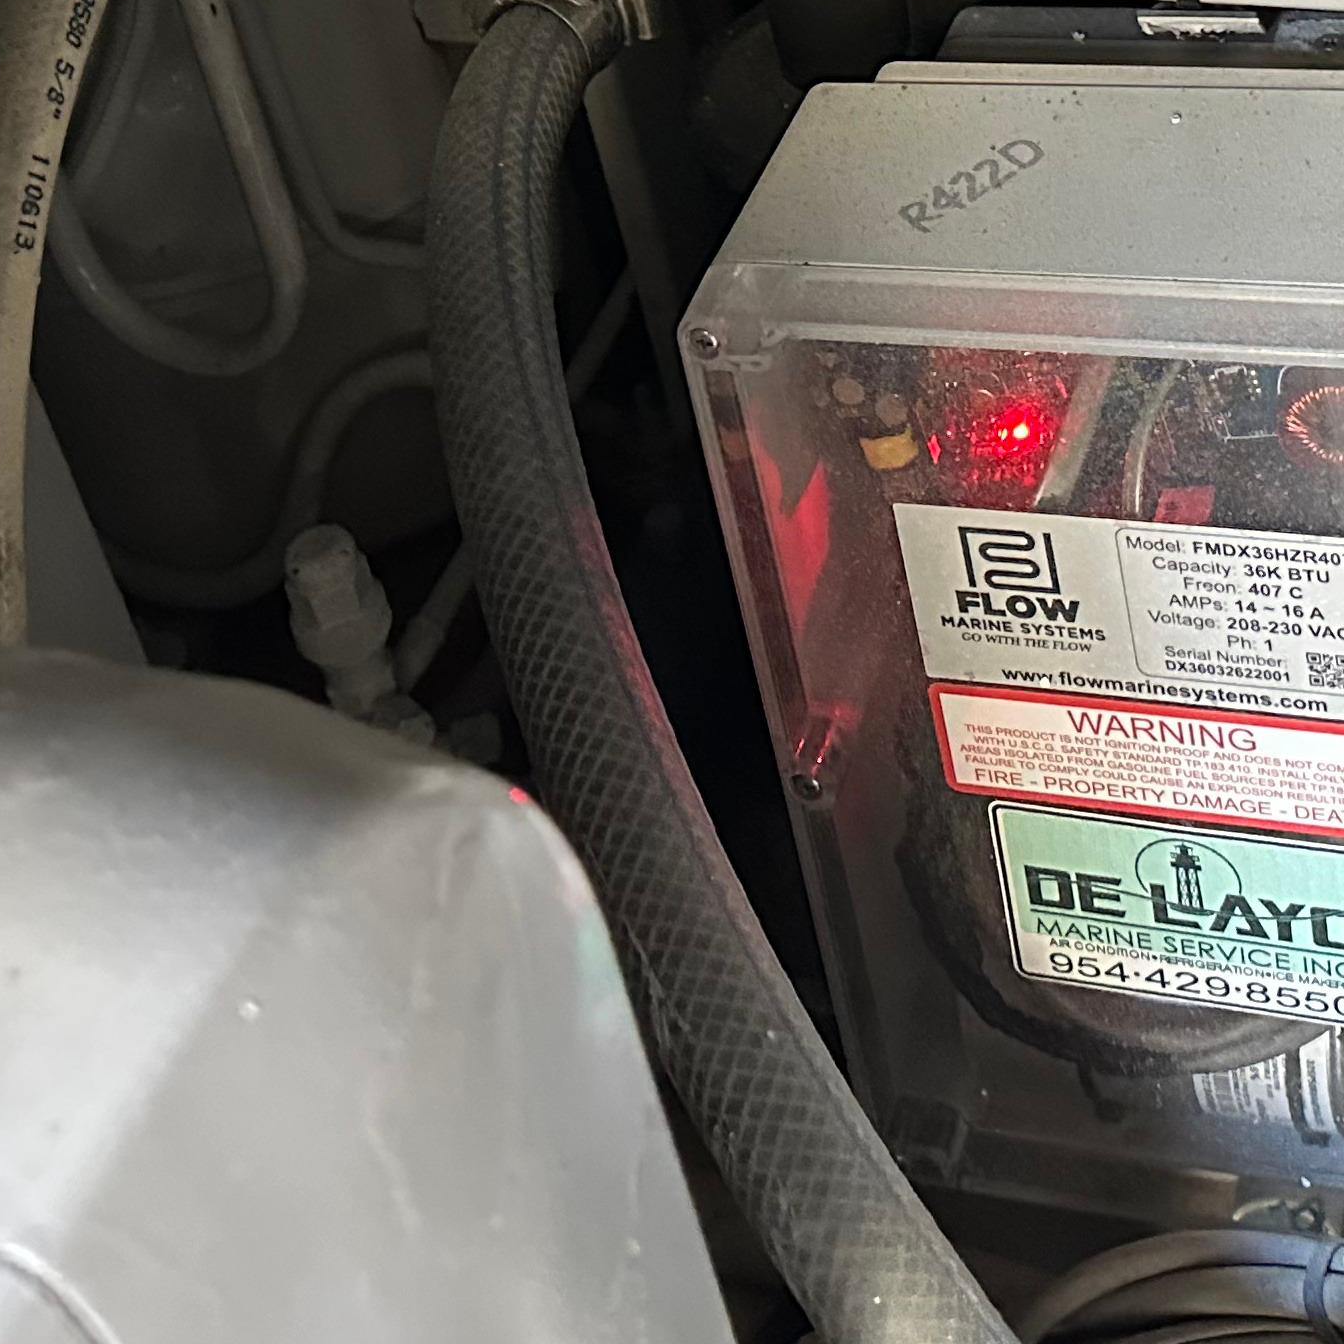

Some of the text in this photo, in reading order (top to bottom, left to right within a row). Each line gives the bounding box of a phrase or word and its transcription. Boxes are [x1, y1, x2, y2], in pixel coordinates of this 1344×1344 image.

[897, 138, 1045, 234] R422D
[1125, 536, 1186, 554] Model:
[1152, 557, 1331, 583] Capacity: 36K BTU
[1183, 577, 1304, 600] Freon: 407 C
[954, 589, 1081, 623] FLOW
[1169, 594, 1227, 612] AMPs:
[1234, 599, 1258, 613] 14
[1284, 603, 1305, 618] 16
[1309, 606, 1325, 620] A
[940, 615, 1107, 642] MARINE SYSTEMS
[1147, 609, 1221, 631] Voltage:
[1226, 616, 1303, 637] 208-230
[962, 631, 1093, 653] GO WITH THE FLOW
[1164, 645, 1212, 662] Serial
[1226, 634, 1274, 652] Ph: 1
[1164, 658, 1292, 683] DX36032622001
[1000, 667, 1330, 713] www.flowmarinesystems.com
[1066, 709, 1258, 752] WARNING
[964, 723, 994, 736] THIS
[995, 726, 1057, 743] PRODUCT
[1059, 733, 1073, 745] IS
[1074, 735, 1102, 747] NOT
[1104, 738, 1162, 754] IGNITION
[1164, 744, 1211, 760] PROOF
[1213, 750, 1241, 763] AND
[1244, 754, 1282, 768] DOES
[1284, 758, 1314, 771] NOT
[973, 735, 1006, 748] WITH
[1059, 744, 1110, 759] SAFETY
[1111, 750, 1183, 768] STANDARD
[1257, 766, 1311, 782] INSTALL
[959, 744, 1002, 758] AREAS
[1003, 747, 1065, 764] ISOLATED
[1066, 754, 1106, 768] FROM
[1107, 759, 1173, 777] GASOLINE
[1174, 767, 1209, 781] FUEL
[1211, 772, 1277, 789] SOURCES
[1279, 778, 1308, 792] PER
[964, 754, 1017, 770] FAILURE
[1018, 759, 1037, 772] TO
[1038, 762, 1092, 779] COMPLY
[1092, 768, 1138, 783] COULD
[1139, 773, 1186, 789] CAUSE
[1187, 778, 1206, 791] AN
[1207, 780, 1285, 800] EXPLOSION
[974, 767, 1025, 788] FIRE
[1043, 774, 1167, 804] PROPERTY
[1172, 790, 1274, 817] DAMAGE
[1023, 863, 1127, 920] DE
[1035, 916, 1154, 952] MARINE
[1162, 933, 1293, 973] SERVICE
[1049, 936, 1072, 949] AIR
